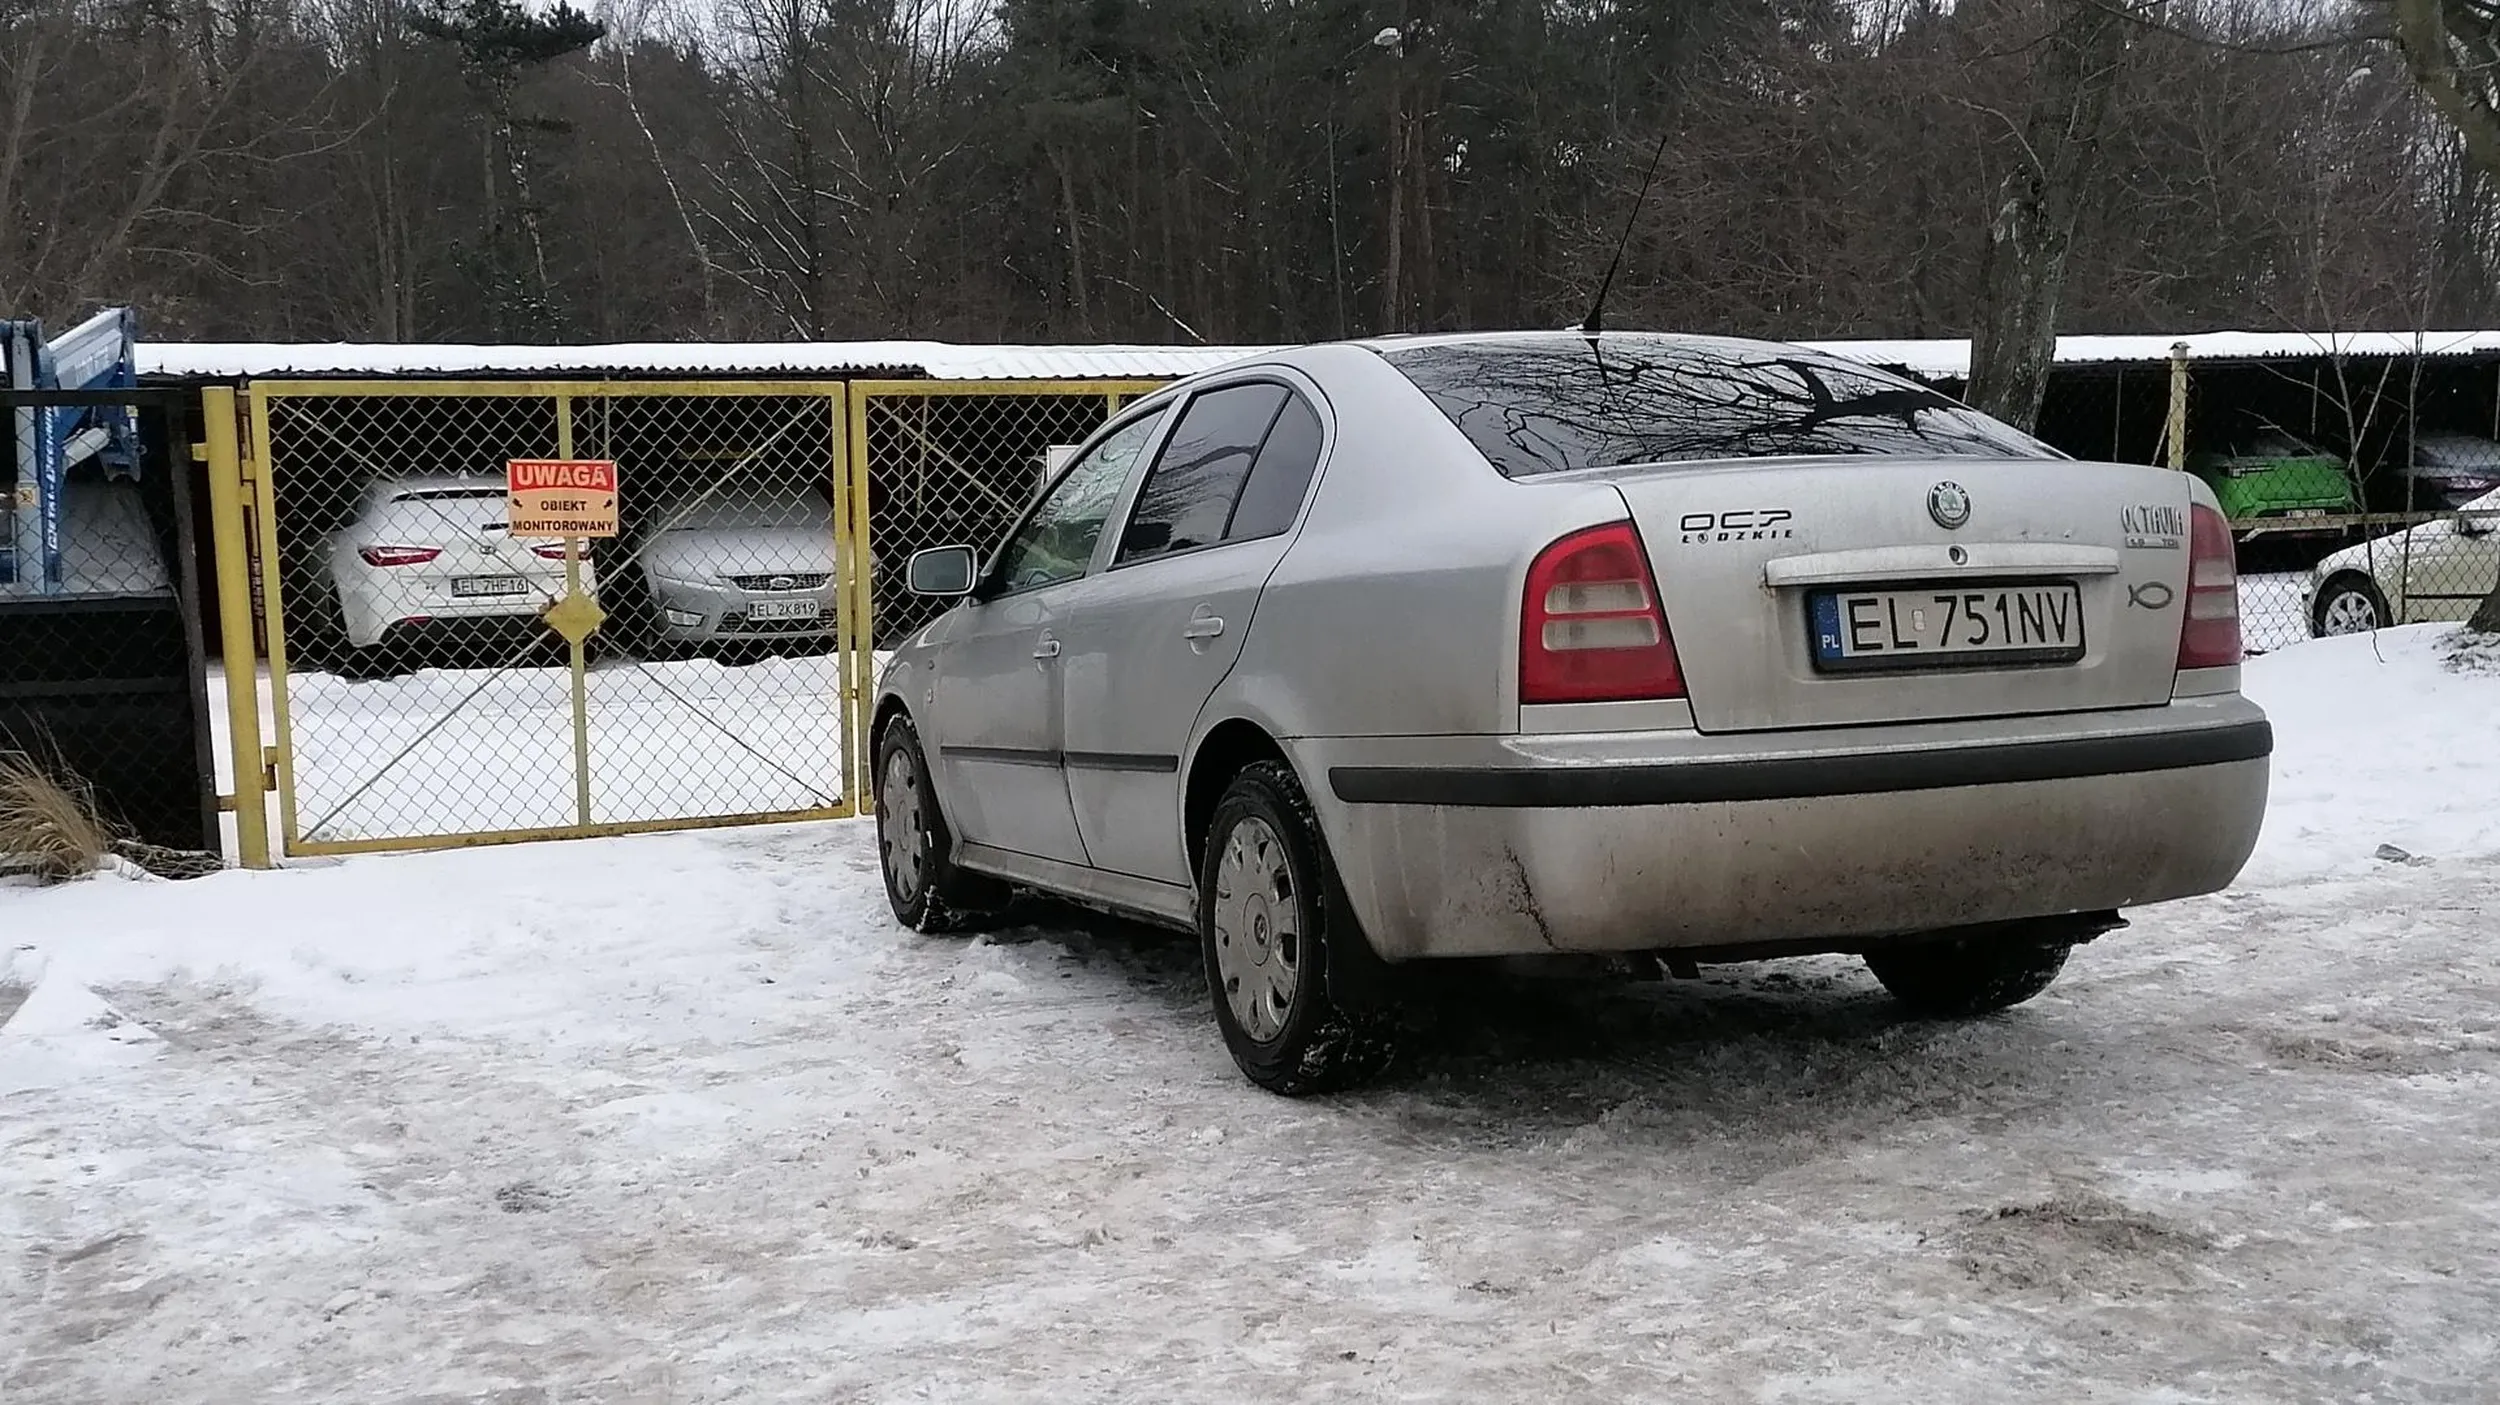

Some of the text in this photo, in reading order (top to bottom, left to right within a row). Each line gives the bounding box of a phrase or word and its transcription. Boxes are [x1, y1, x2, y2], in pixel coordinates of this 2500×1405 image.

[516, 465, 608, 487] UWAGA
[540, 500, 587, 511] OBIEKT
[513, 521, 613, 531] MONITOROWANY
[2121, 505, 2184, 536] OCTAVIA
[461, 580, 478, 592] EL
[757, 603, 816, 616] EL 2K819
[1848, 592, 2068, 651] EL 751NV
[1822, 634, 1839, 648] PL
